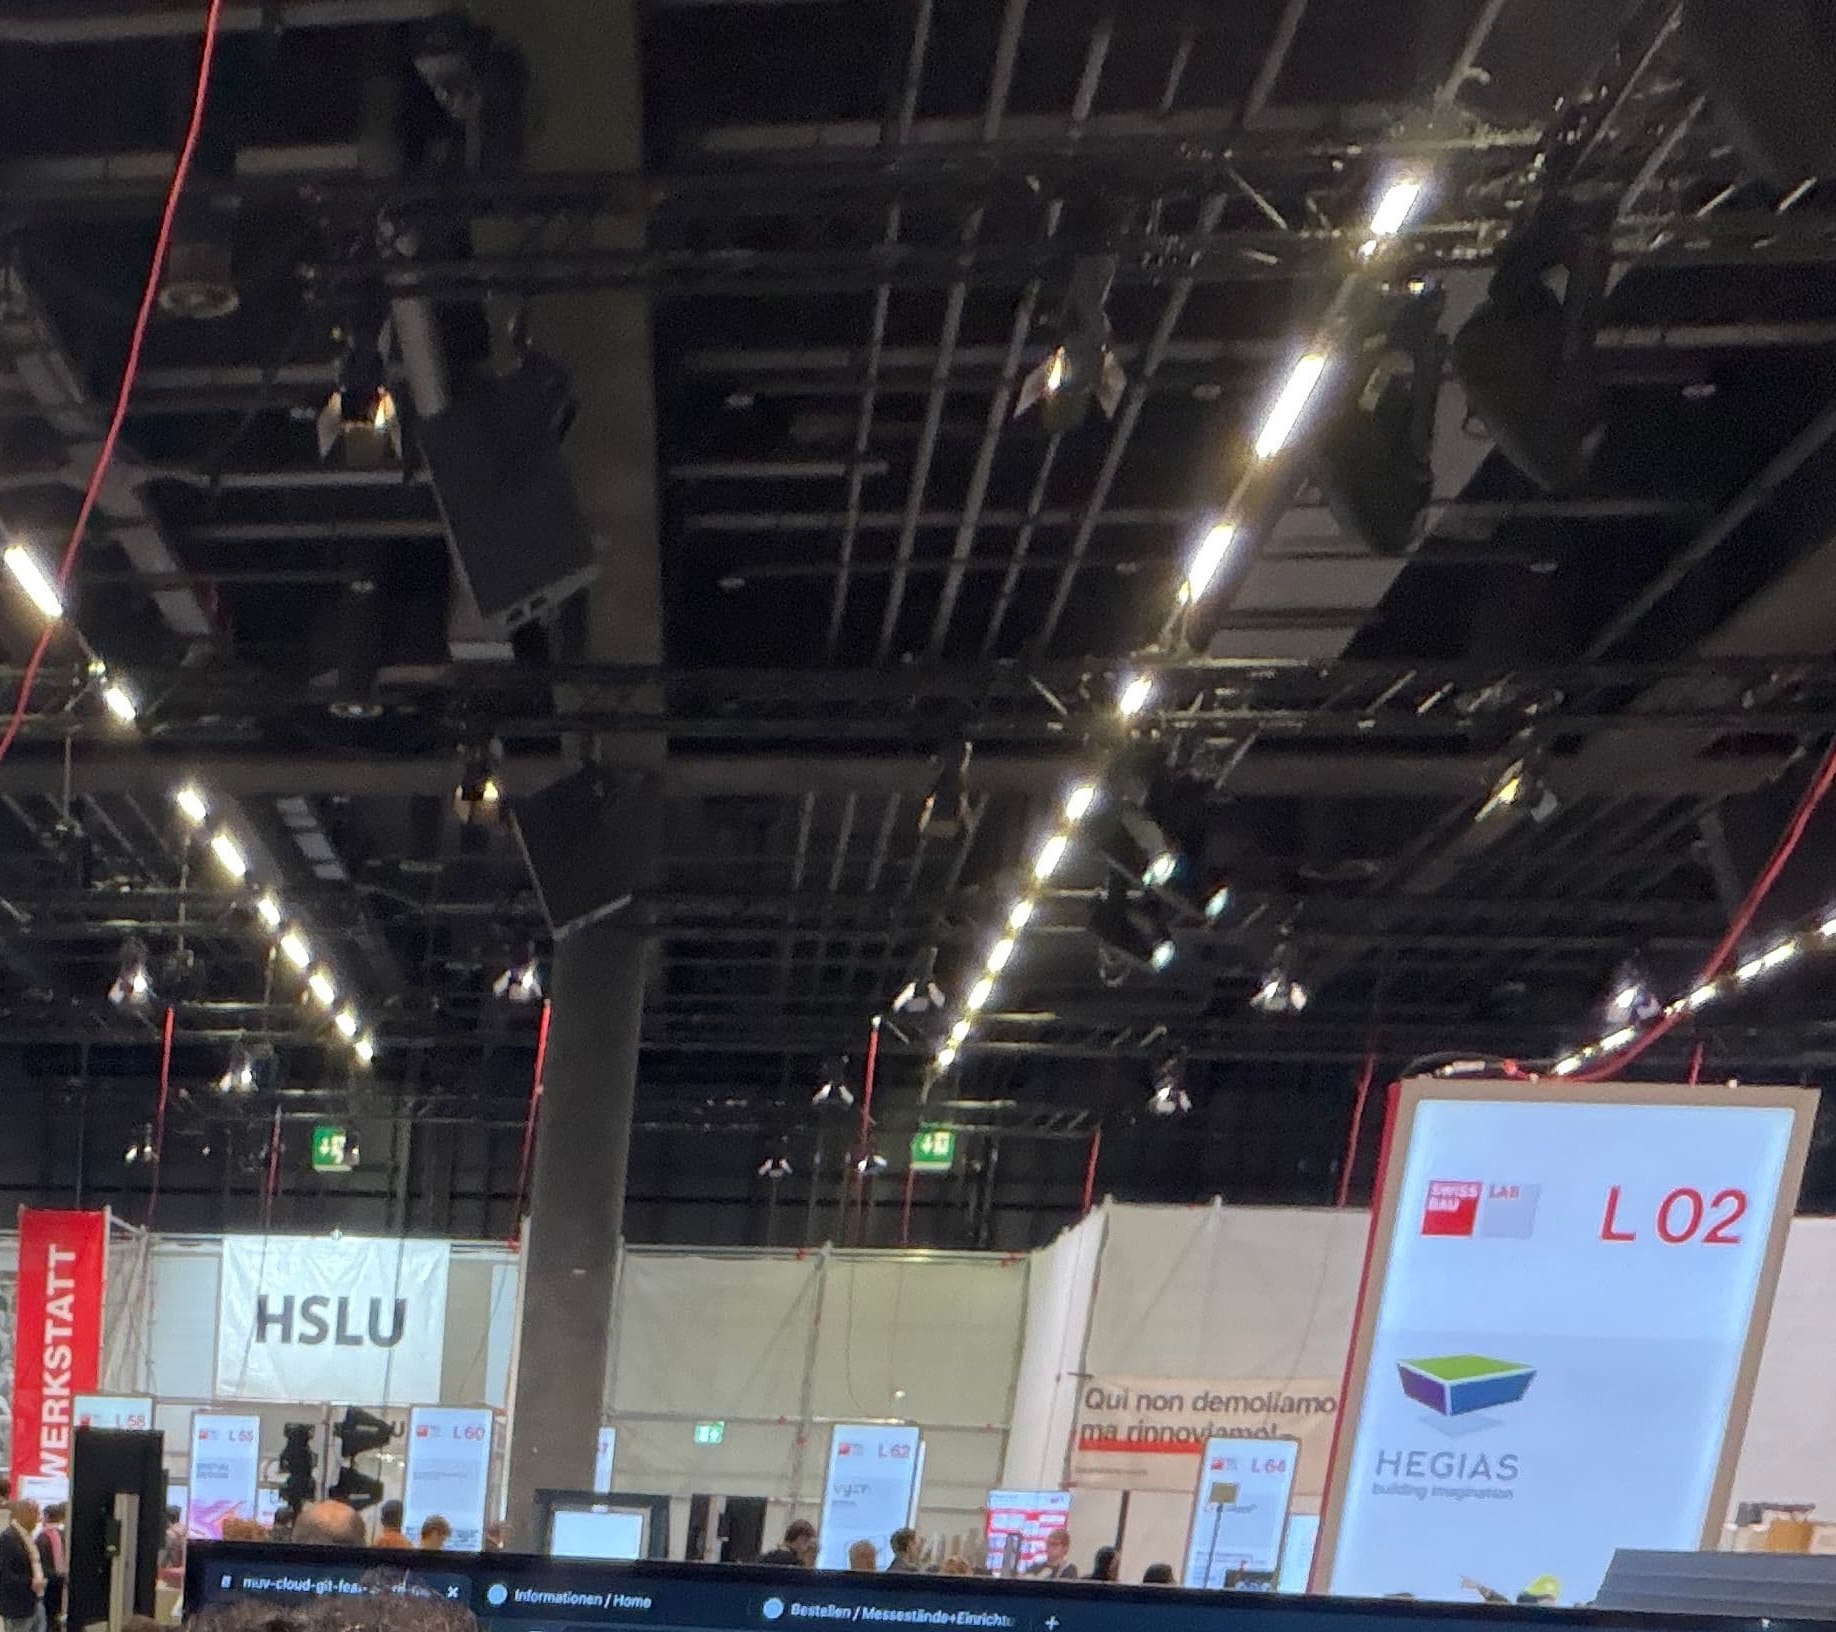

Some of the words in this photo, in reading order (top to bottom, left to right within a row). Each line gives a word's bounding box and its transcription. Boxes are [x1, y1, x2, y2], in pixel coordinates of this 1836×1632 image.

[1600, 1185, 1636, 1242] L
[1656, 1186, 1748, 1245] 02
[256, 1294, 407, 1348] HSLU
[39, 1243, 77, 1479] WERKSTATT
[1084, 1387, 1129, 1411] Qui
[1137, 1394, 1184, 1412] non
[1192, 1390, 1338, 1415] demoliamo
[1081, 1422, 1118, 1441] ma
[1375, 1450, 1519, 1481] HEGIAS
[515, 1588, 603, 1606] Informationen
[613, 1594, 652, 1609] Home
[790, 1603, 851, 1619] Bestellen
